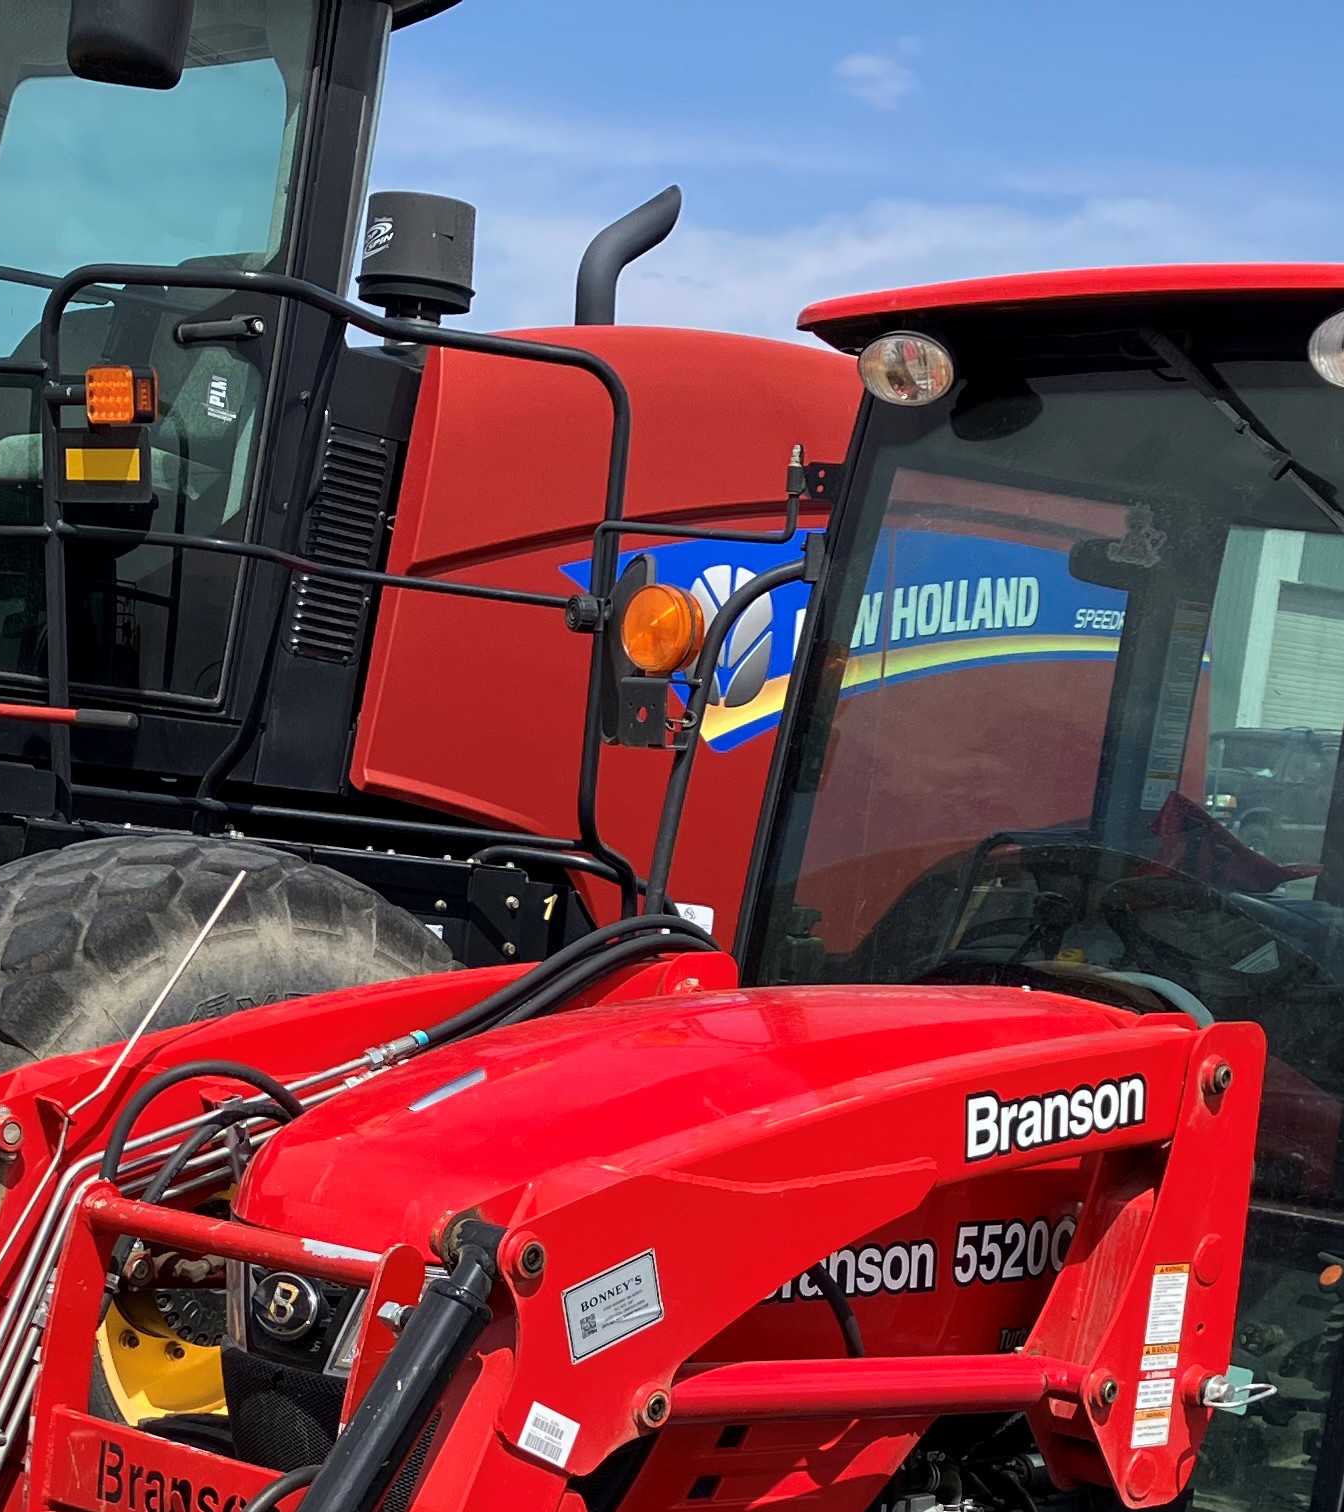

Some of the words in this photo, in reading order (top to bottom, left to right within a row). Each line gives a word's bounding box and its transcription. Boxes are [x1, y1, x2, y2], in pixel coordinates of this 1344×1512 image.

[891, 576, 1040, 641] HOLLAND
[966, 1076, 1146, 1159] Branson
[580, 1274, 643, 1313] BONNEY'S
